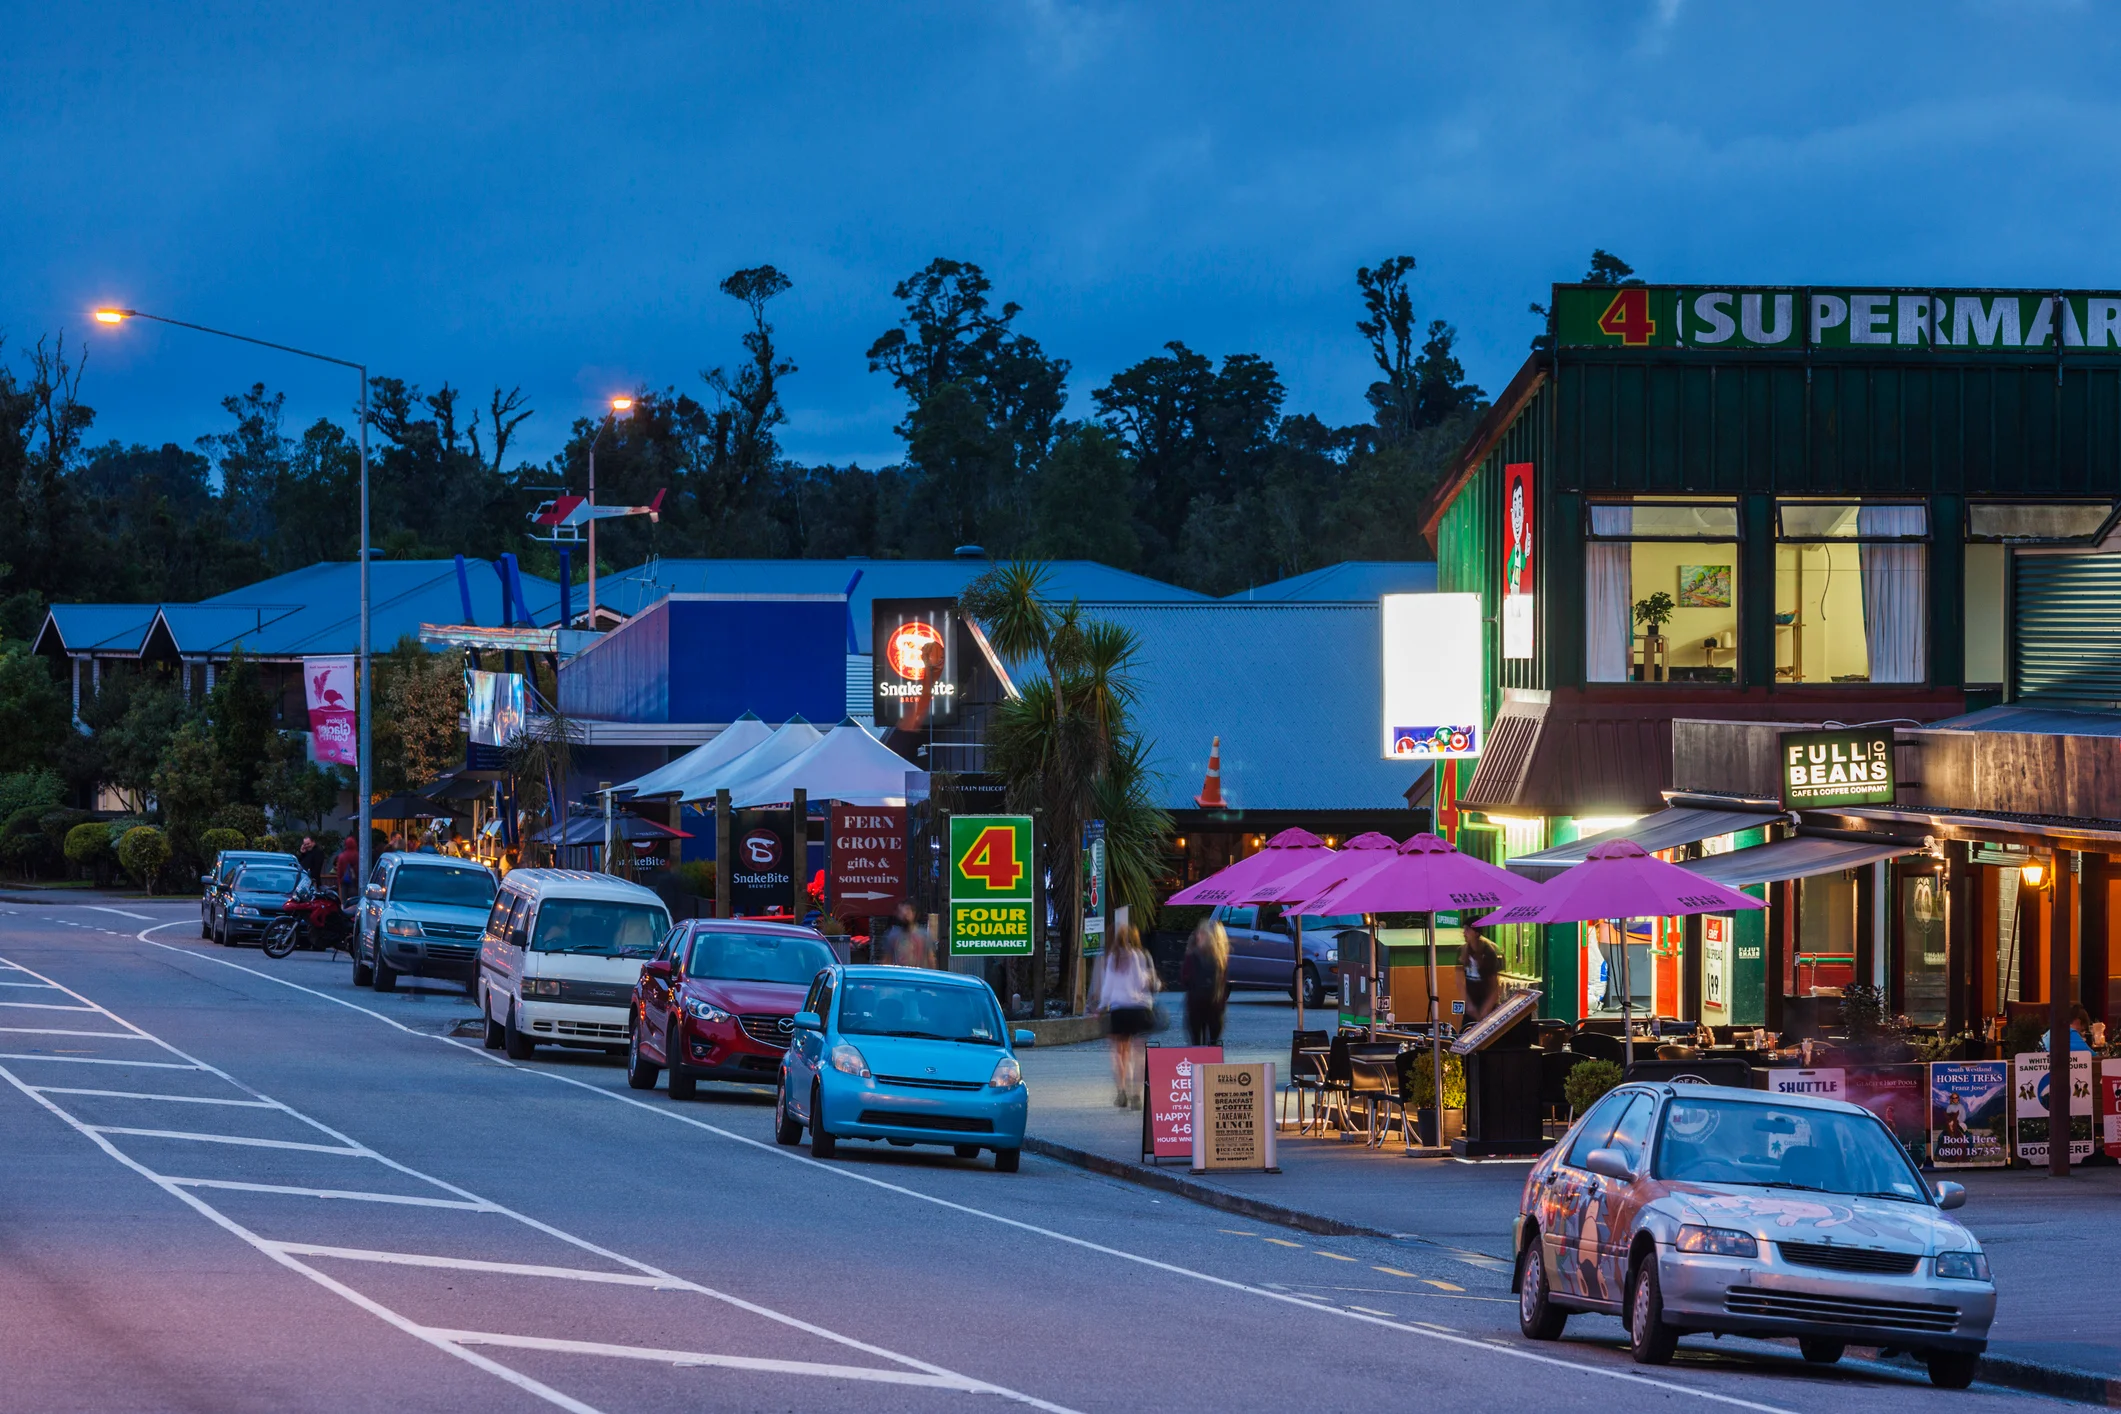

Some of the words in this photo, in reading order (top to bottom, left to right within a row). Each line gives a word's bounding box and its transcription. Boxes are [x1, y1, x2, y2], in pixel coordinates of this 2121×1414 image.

[1597, 288, 1656, 346] 4
[880, 681, 954, 697] Snakeite
[1789, 742, 1866, 765] FULL
[1873, 740, 1886, 760] OF
[1790, 761, 1887, 785] BEANS
[1792, 789, 1812, 797] CAFE
[1813, 788, 1819, 796] &
[1820, 786, 1849, 796] COFFEE
[1850, 785, 1888, 794] COMPANY
[844, 816, 895, 829] FERN
[836, 837, 902, 850] GROVE
[957, 825, 1023, 890] 4
[847, 857, 875, 871] gifts
[877, 857, 890, 868] &
[733, 873, 789, 884] SnakeBite
[839, 873, 899, 884] souvenirs
[1453, 896, 1500, 904] BEANS
[956, 908, 1027, 921] FOUR
[956, 922, 1027, 936] SQUARE
[956, 939, 1027, 948] SUPERMARKET
[1171, 1079, 1192, 1089] KEE
[1937, 1075, 1969, 1083] HORSE
[1972, 1074, 2003, 1082] TREKS
[1778, 1081, 1838, 1093] SHUTTLE
[1156, 1113, 1191, 1121] HAPPY
[1215, 1121, 1253, 1129] LUNCH
[1943, 1135, 1970, 1144] Book
[1972, 1135, 1997, 1143] Here
[1938, 1148, 1963, 1156] 0800
[1966, 1147, 2001, 1156] 187357
[2021, 1146, 2050, 1156] BOO
[2069, 1144, 2090, 1153] ERE
